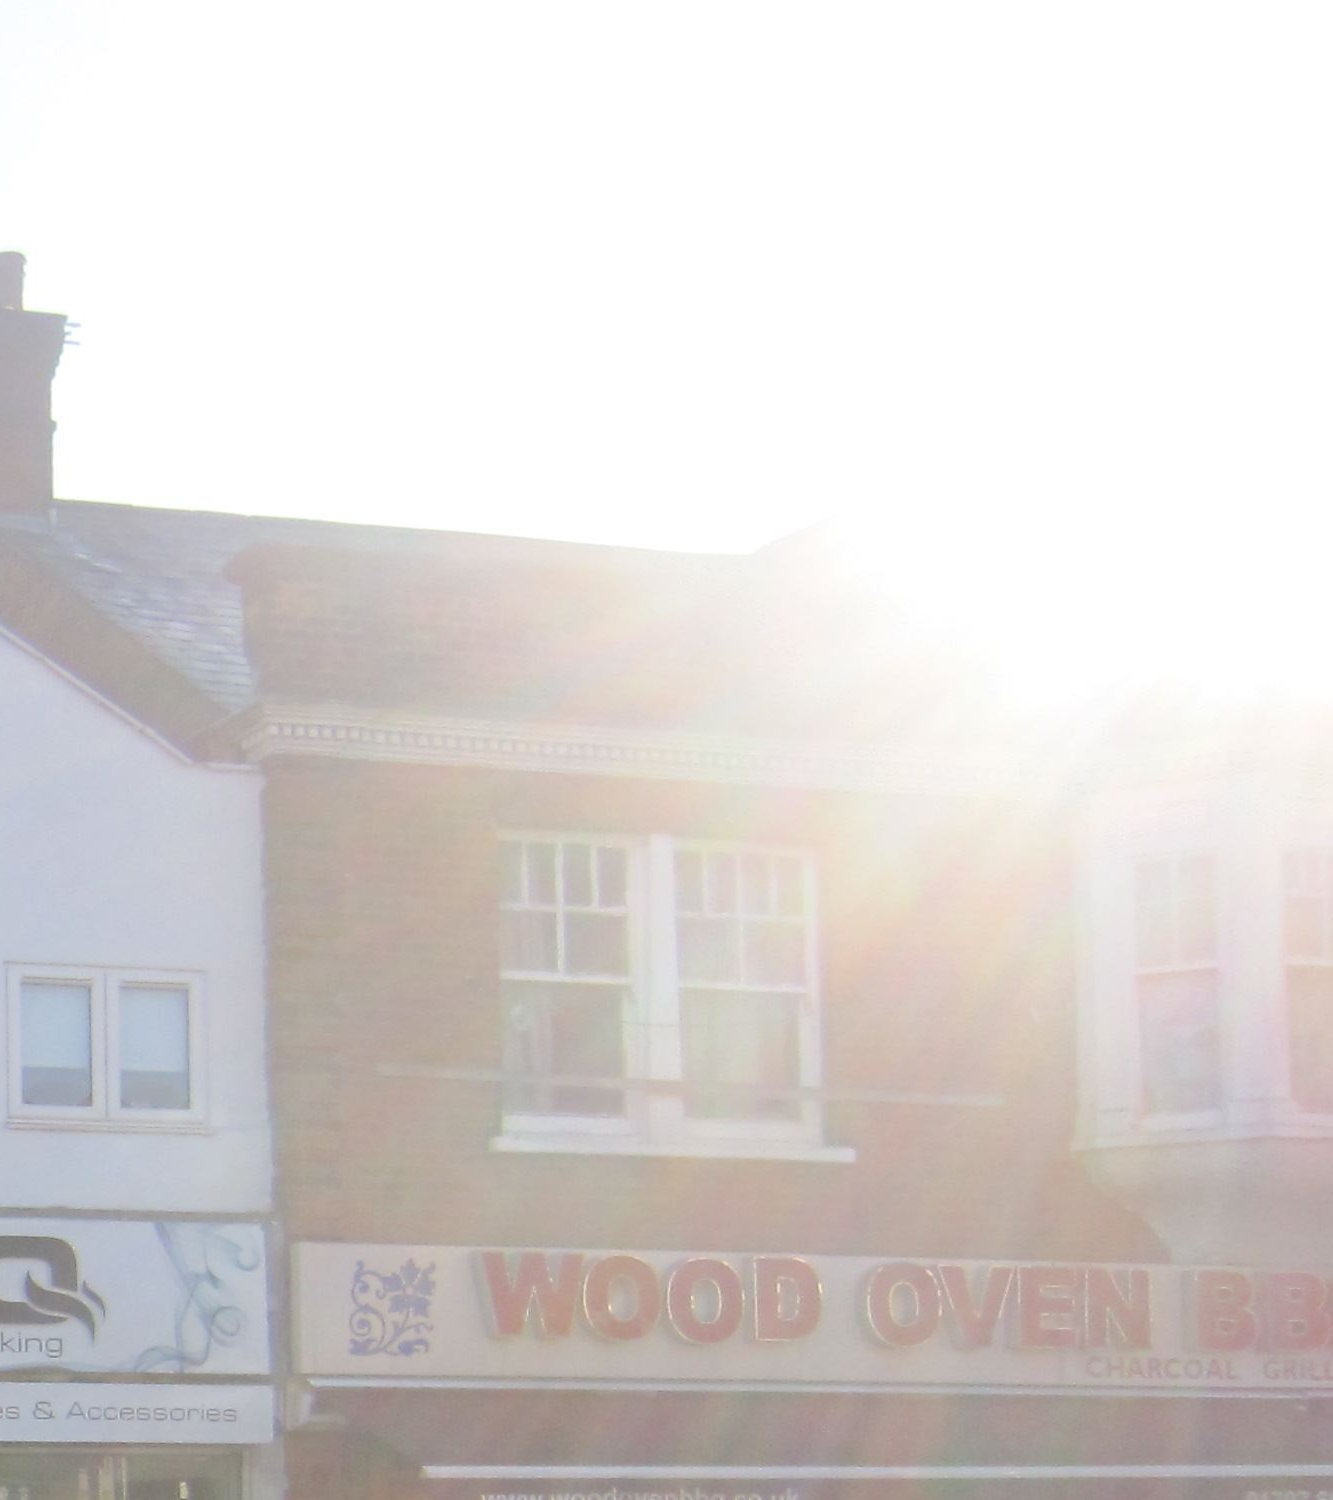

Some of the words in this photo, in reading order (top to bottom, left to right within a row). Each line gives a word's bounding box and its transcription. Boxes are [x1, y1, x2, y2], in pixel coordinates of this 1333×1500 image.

[479, 1250, 824, 1344] WOOD
[866, 1262, 1152, 1350] OVEN
[1193, 1268, 1333, 1352] BB
[1084, 1355, 1238, 1380] CHARCOAL
[33, 1401, 56, 1420] &
[66, 1401, 239, 1423] Accessories
